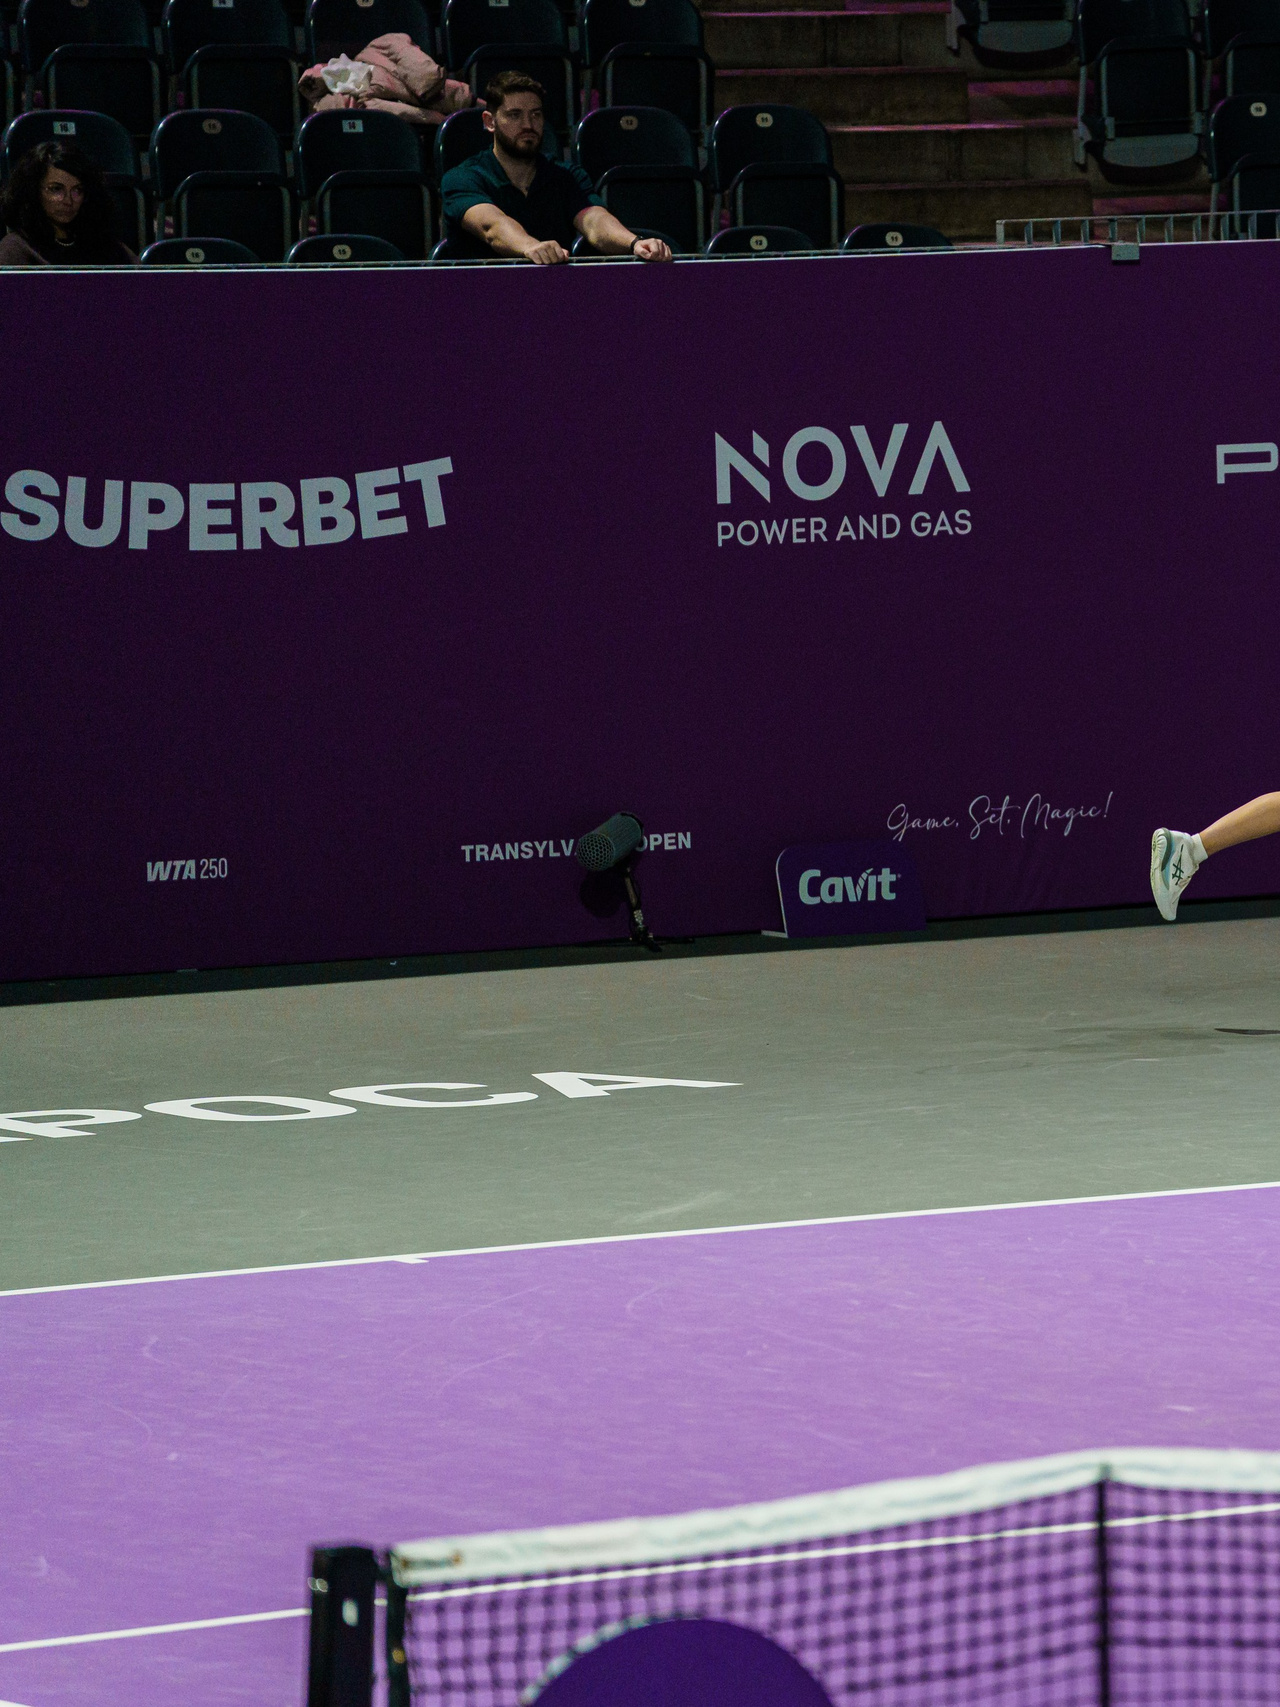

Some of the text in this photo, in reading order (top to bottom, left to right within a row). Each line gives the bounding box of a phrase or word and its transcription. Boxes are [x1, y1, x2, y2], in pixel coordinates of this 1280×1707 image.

[715, 420, 971, 504] NOVA
[0, 456, 454, 551] SUPERBET
[717, 508, 972, 547] POWER AND GAS
[146, 857, 228, 882] WTA 250
[798, 867, 897, 906] Cavit
[0, 1071, 744, 1142] POCA
